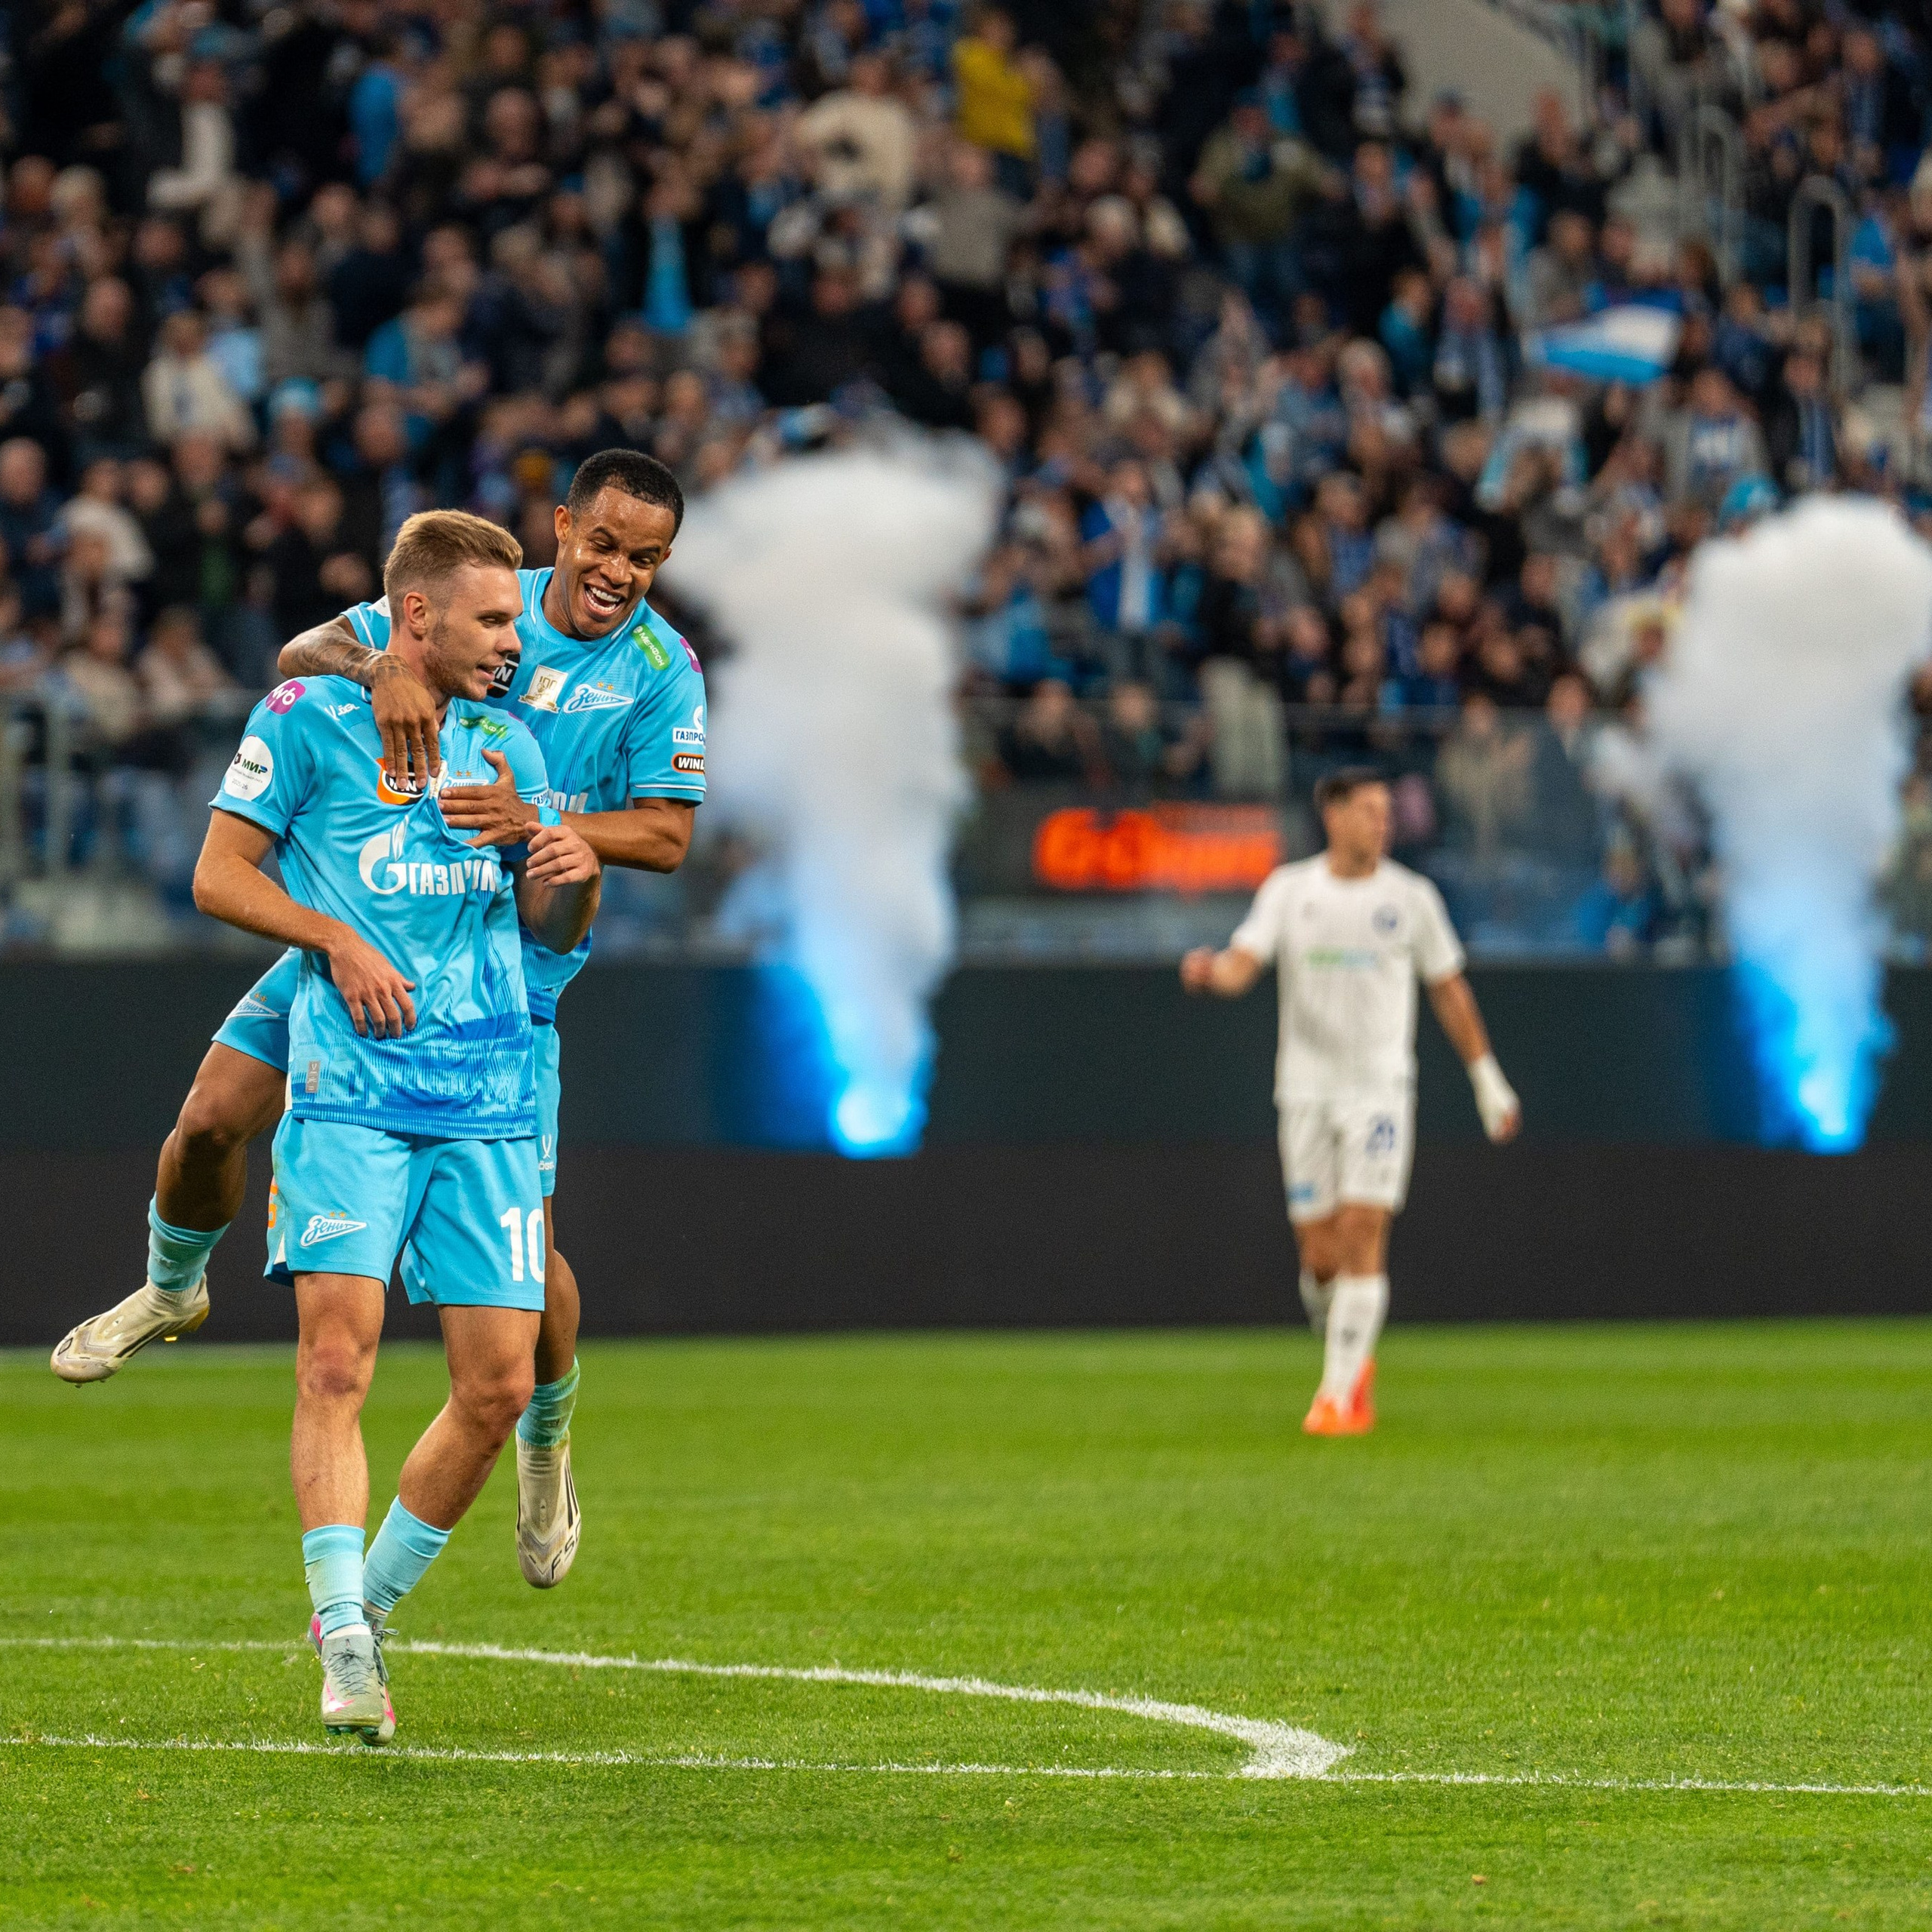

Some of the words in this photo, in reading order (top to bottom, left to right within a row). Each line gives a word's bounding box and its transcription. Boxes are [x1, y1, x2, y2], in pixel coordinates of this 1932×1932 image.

[675, 731, 706, 744] ГАЗПРО
[242, 758, 268, 774] МИР
[500, 1207, 545, 1283] 10
